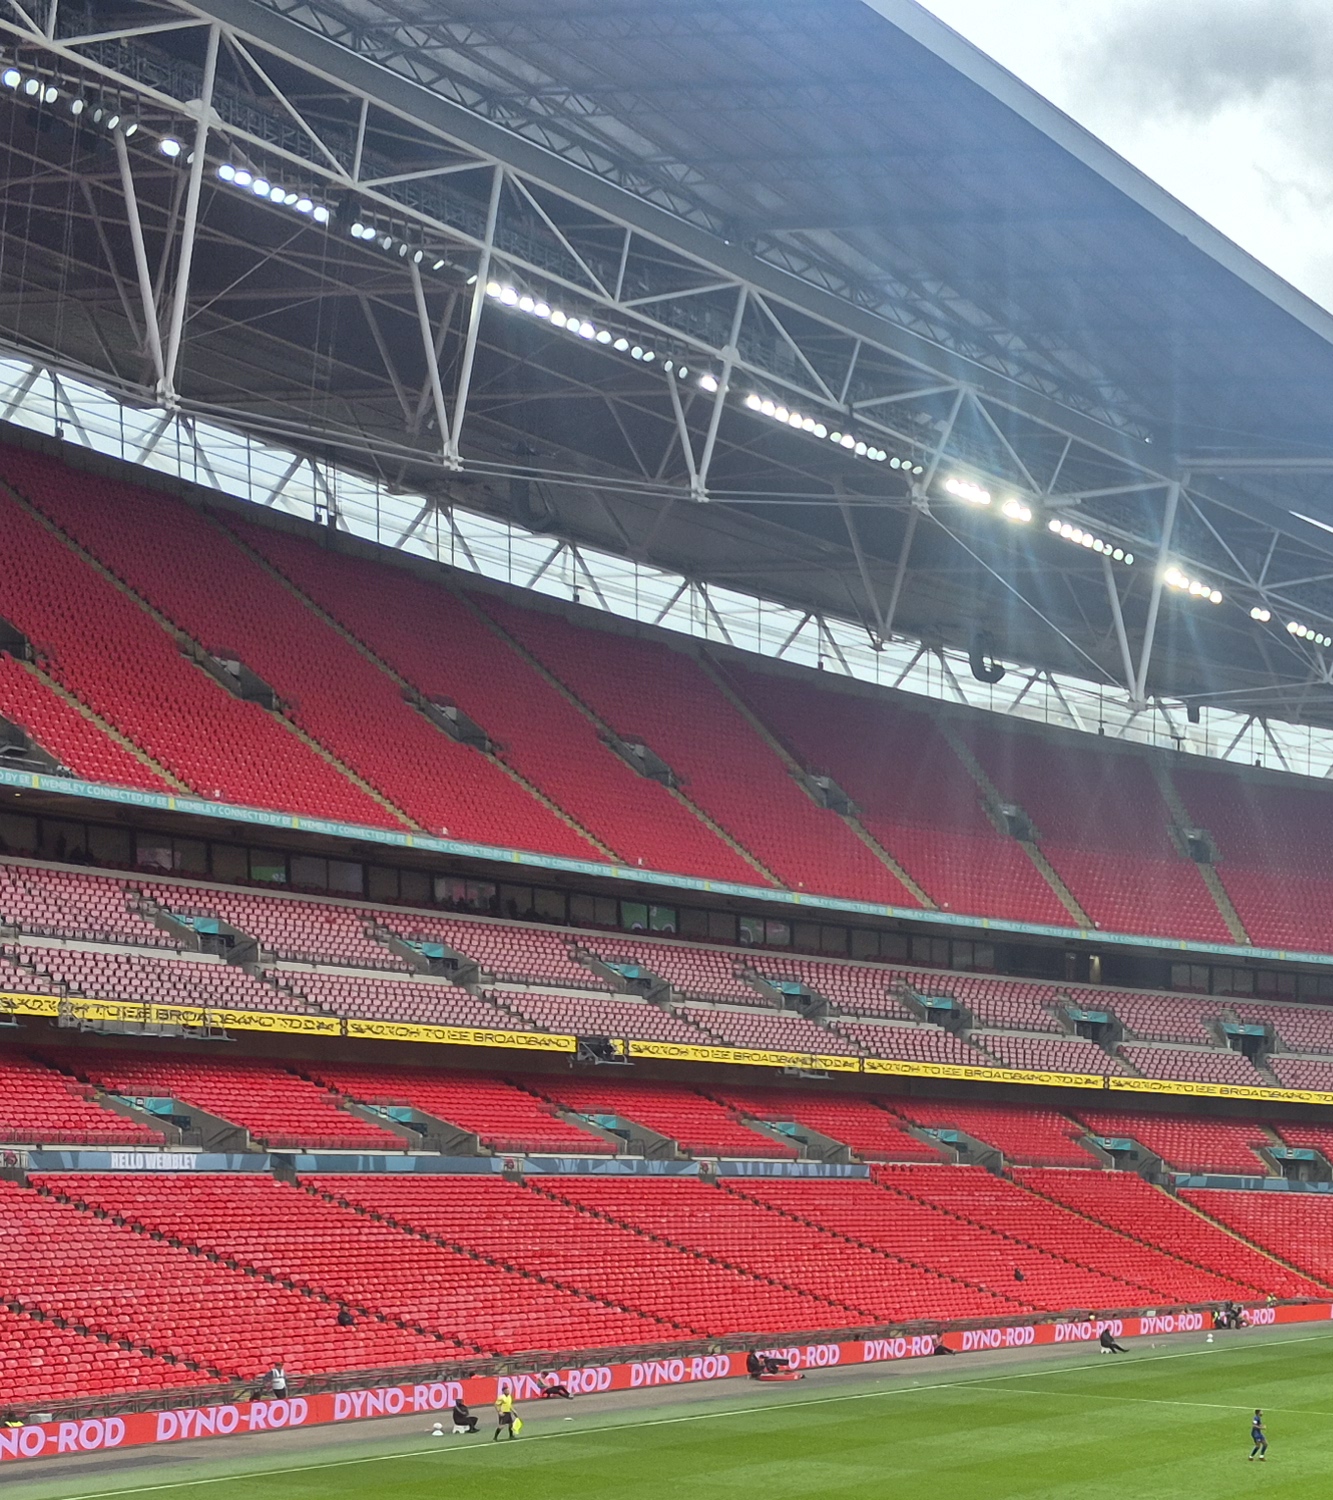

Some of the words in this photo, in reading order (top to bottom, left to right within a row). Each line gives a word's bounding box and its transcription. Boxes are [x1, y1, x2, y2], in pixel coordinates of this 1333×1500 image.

[40, 777, 85, 795] WEMBLEY
[87, 786, 143, 802] CONNECTED
[144, 794, 156, 803] BY
[157, 796, 167, 805] EE
[175, 799, 216, 813] WEMBLEY
[218, 804, 269, 821] CONNECTED
[270, 814, 280, 823] BY
[282, 817, 291, 825] EE
[111, 1152, 144, 1169] HELLO
[144, 1153, 197, 1169] WEMBLEY
[1140, 1313, 1203, 1334] DYNO-ROD
[863, 1335, 935, 1361] DYNO-RO
[962, 1326, 1035, 1350] DYNO-ROD
[631, 1354, 731, 1387] DYNO-ROD
[334, 1380, 464, 1420] DYNO-ROD
[157, 1398, 309, 1441] DYNO-ROD
